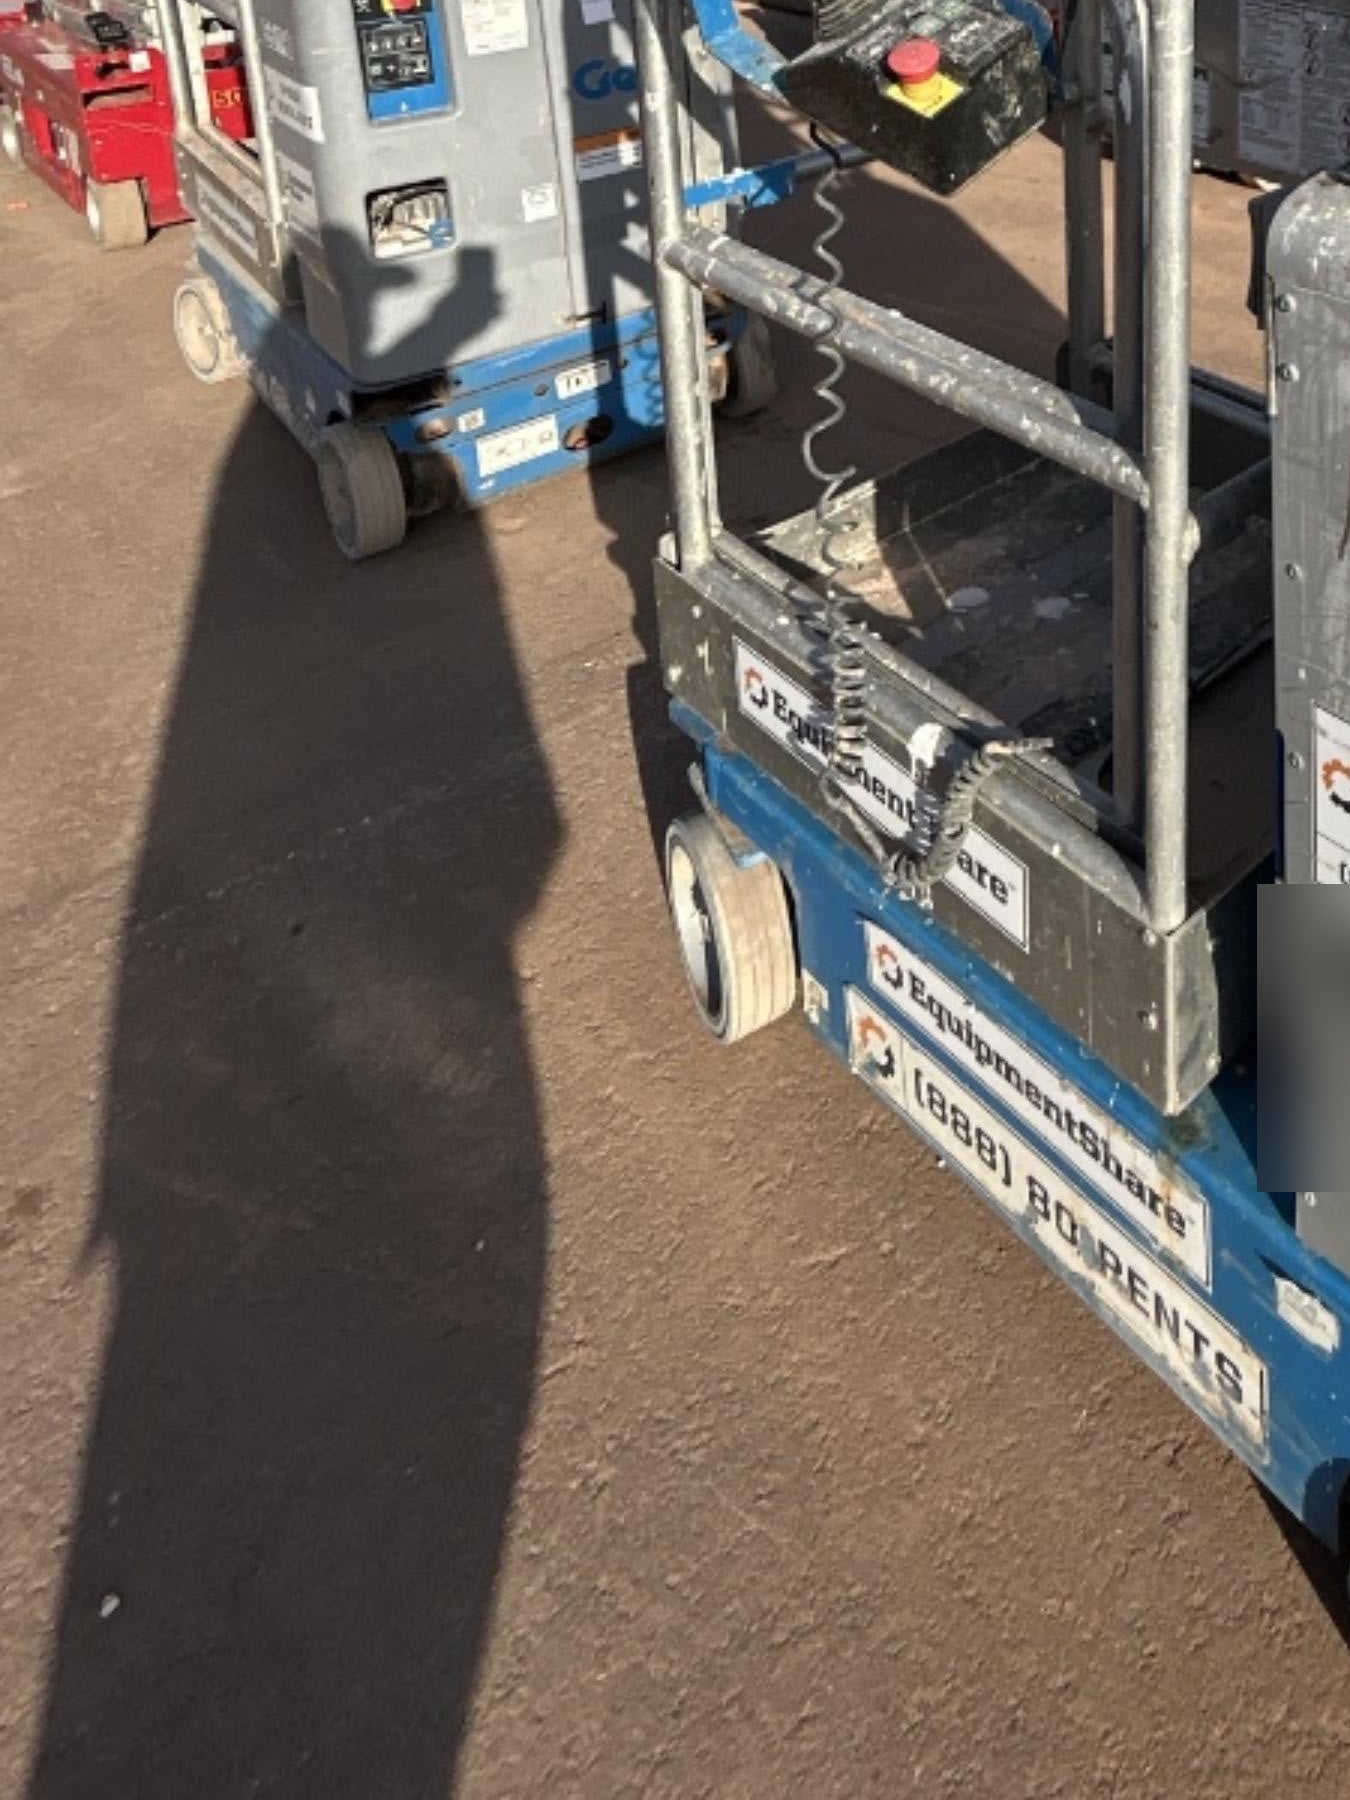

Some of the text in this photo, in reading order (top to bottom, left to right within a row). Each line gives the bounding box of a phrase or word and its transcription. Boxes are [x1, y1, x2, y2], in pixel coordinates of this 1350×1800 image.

[574, 59, 637, 99] Ge
[773, 692, 1009, 904] Equientare
[908, 969, 1187, 1239] EquipmentShare
[913, 1067, 1012, 1187] (888)
[1026, 1172, 1079, 1247] 80
